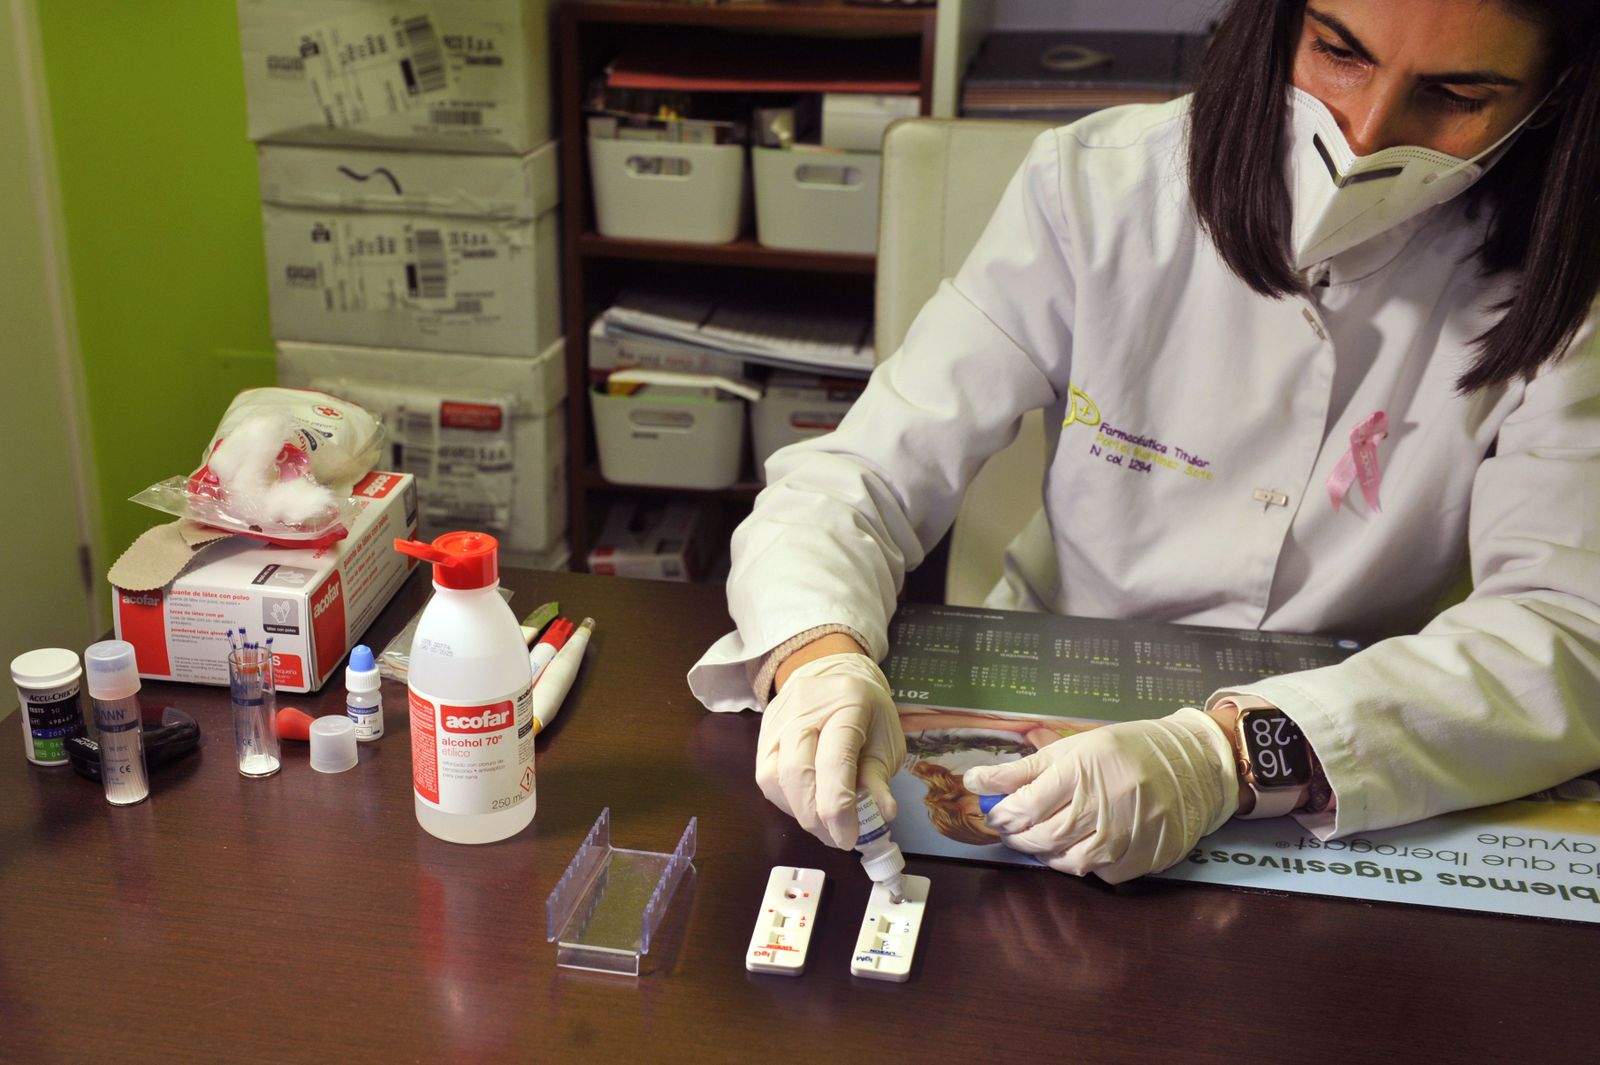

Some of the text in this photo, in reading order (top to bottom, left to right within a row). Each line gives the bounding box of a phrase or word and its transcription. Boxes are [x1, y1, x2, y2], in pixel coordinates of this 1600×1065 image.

[1106, 453, 1123, 466] col
[1128, 458, 1152, 474] 1294
[1174, 446, 1210, 468] Titular
[122, 594, 161, 607] acofar
[313, 581, 340, 619] acofar
[445, 709, 510, 730] acofar
[441, 737, 483, 748] alcohol
[1258, 748, 1293, 778] 16
[491, 796, 511, 810] 250
[1477, 833, 1597, 854] ayude
[1481, 854, 1556, 872] que
